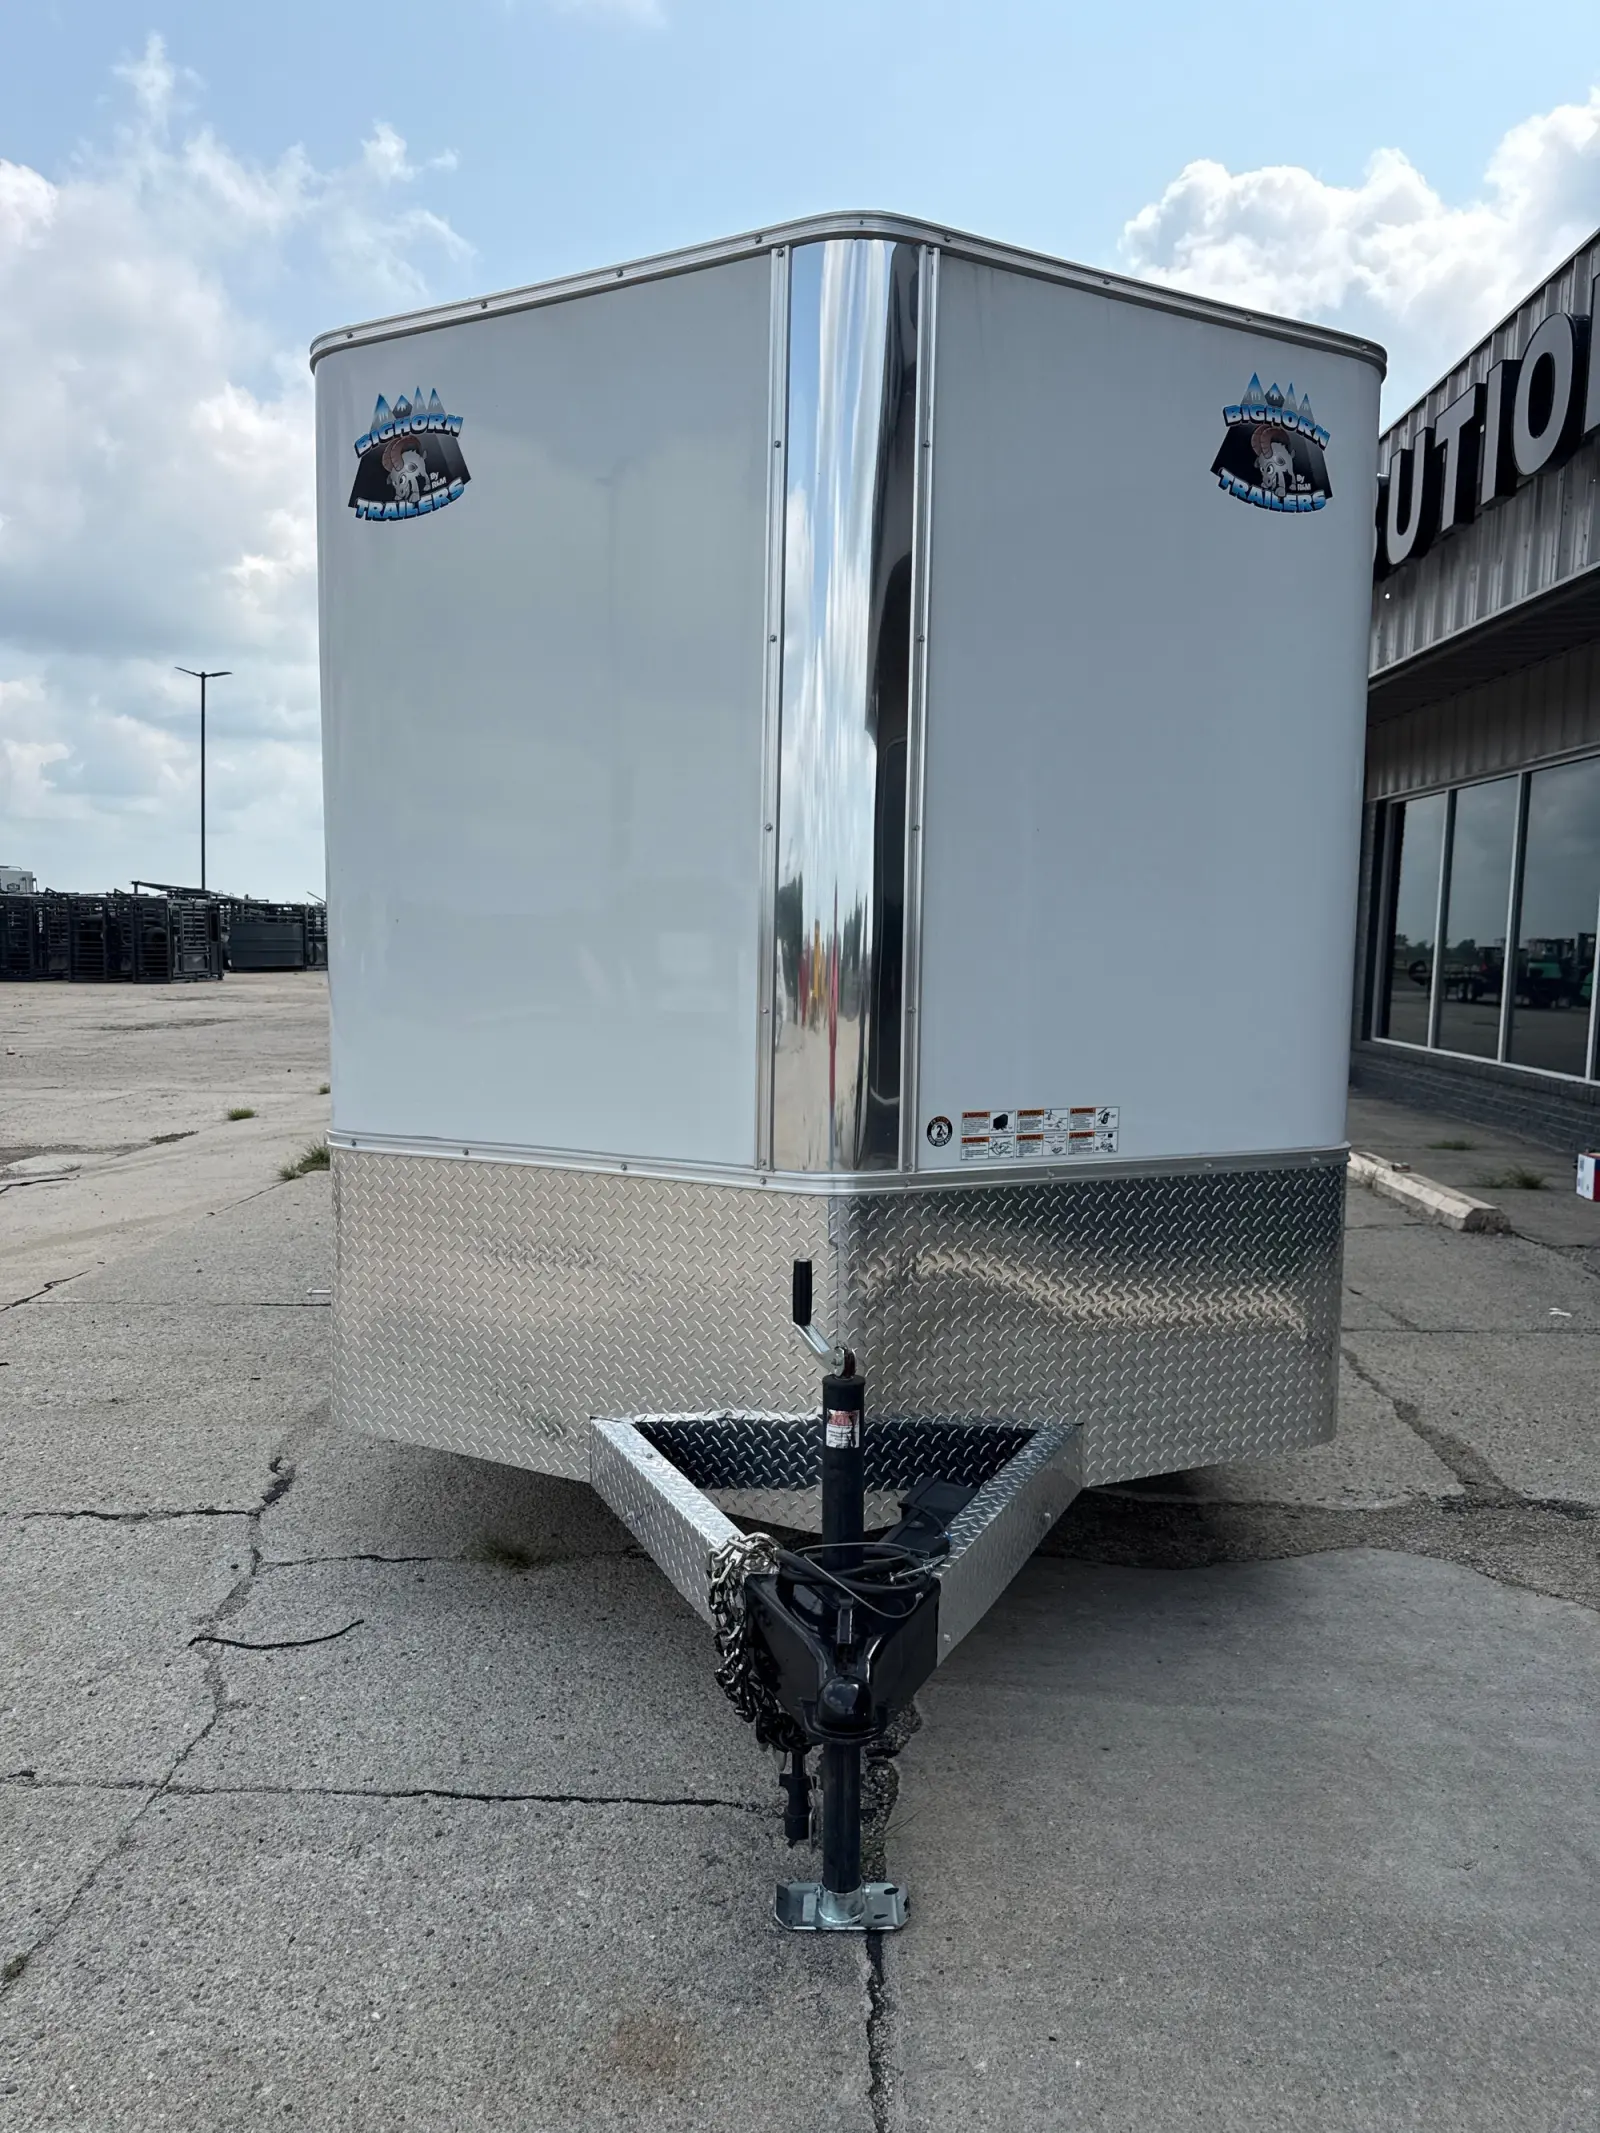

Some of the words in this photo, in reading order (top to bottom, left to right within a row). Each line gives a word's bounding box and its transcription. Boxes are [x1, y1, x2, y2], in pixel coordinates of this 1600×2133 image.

[354, 413, 463, 458] BIGHORN
[1223, 404, 1331, 450] BIGHORN
[355, 478, 465, 521] TRAILERS
[1218, 467, 1327, 512] TRAILERS
